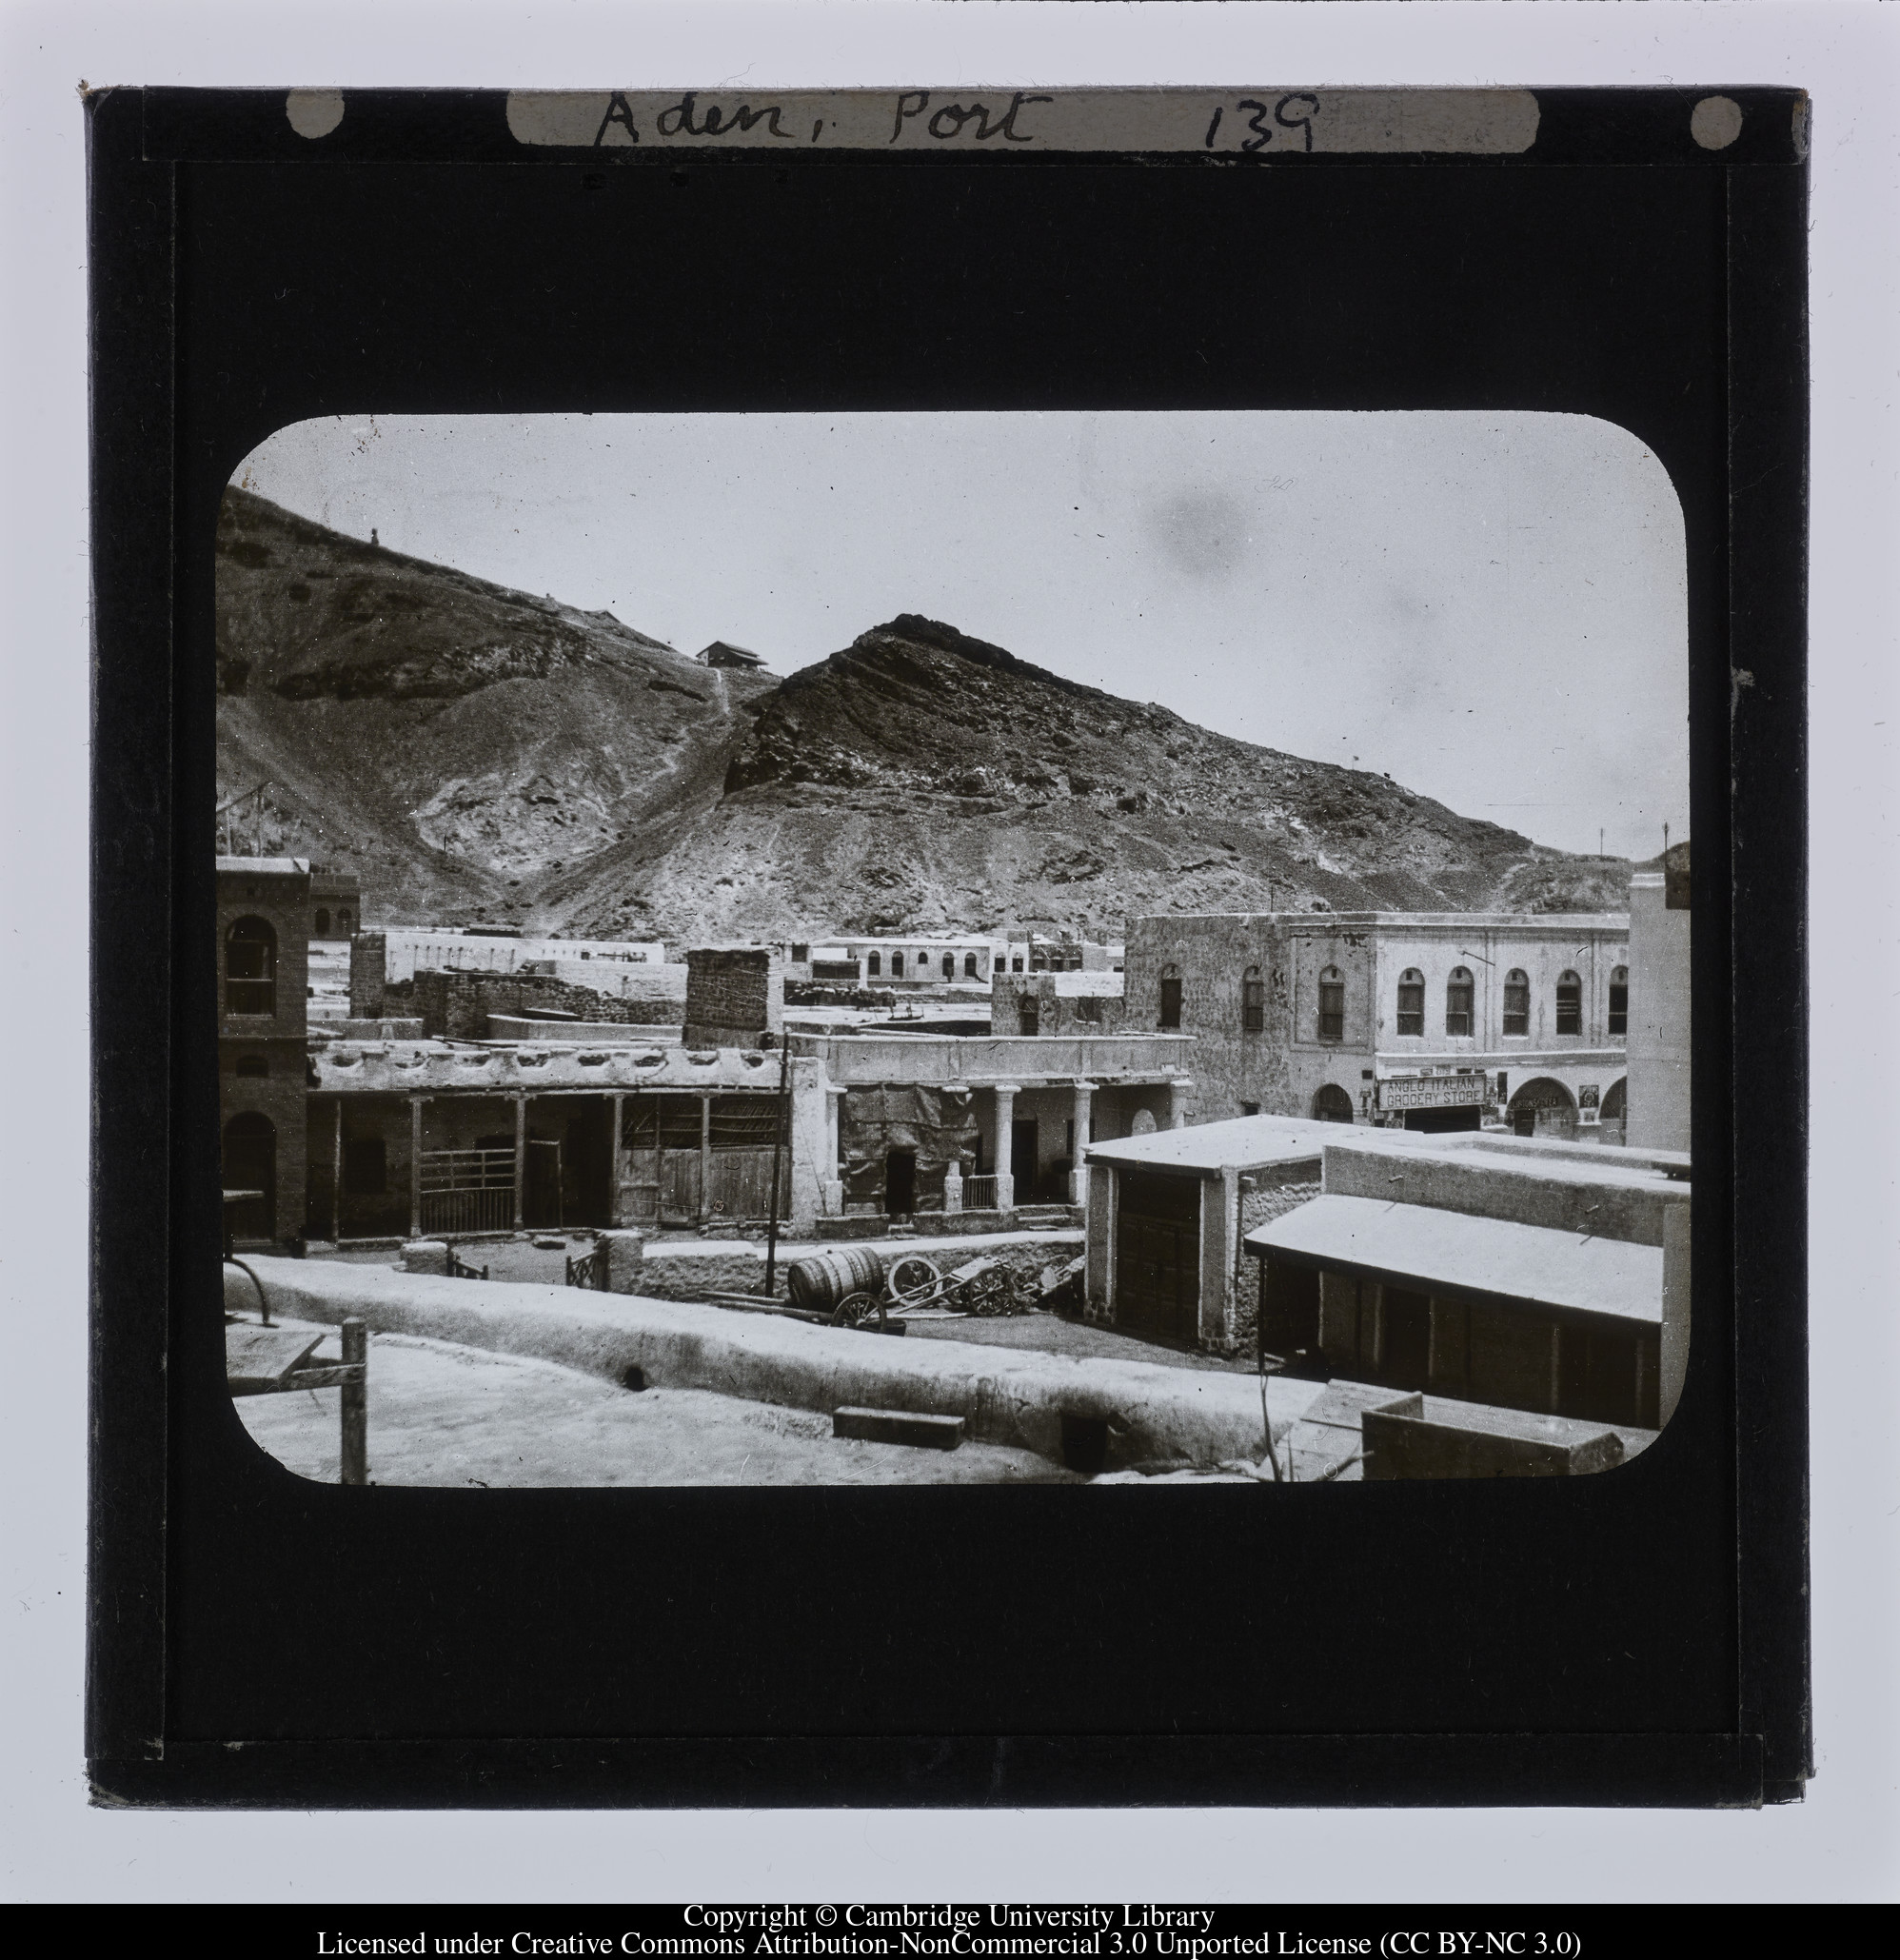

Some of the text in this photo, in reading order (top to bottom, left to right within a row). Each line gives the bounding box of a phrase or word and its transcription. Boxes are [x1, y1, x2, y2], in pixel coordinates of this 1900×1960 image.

[890, 90, 1054, 144] Port
[1205, 93, 1320, 152] 139
[1387, 1077, 1475, 1094] ANGLO ITALIAN
[1443, 1090, 1481, 1104] STORE
